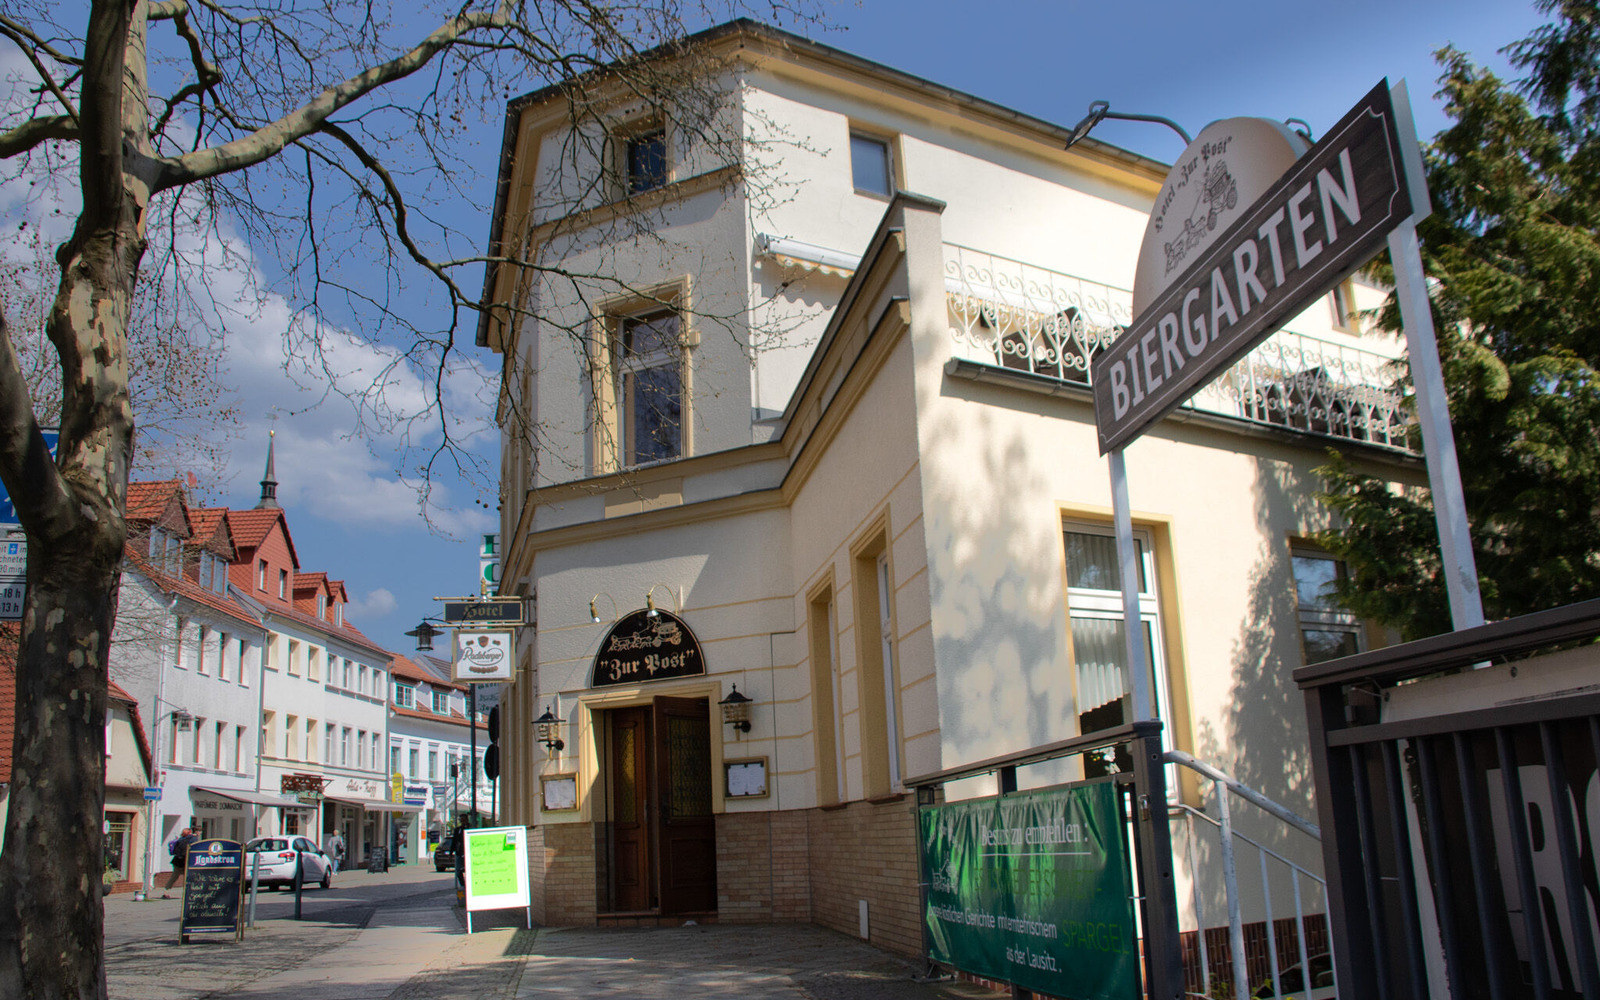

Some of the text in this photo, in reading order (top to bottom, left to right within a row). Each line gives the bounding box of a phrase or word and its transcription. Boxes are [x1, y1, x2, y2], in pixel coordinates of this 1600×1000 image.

[1109, 146, 1362, 422] BIERGARTEN
[463, 602, 503, 619] Hotel
[462, 646, 502, 662] Radeberger
[1011, 827, 1023, 846] zu
[1025, 816, 1081, 853] empfehlen
[194, 854, 236, 867] Landskron
[965, 906, 996, 929] Gerichte
[1062, 918, 1130, 955] SPARGEL
[1014, 942, 1026, 966] der
